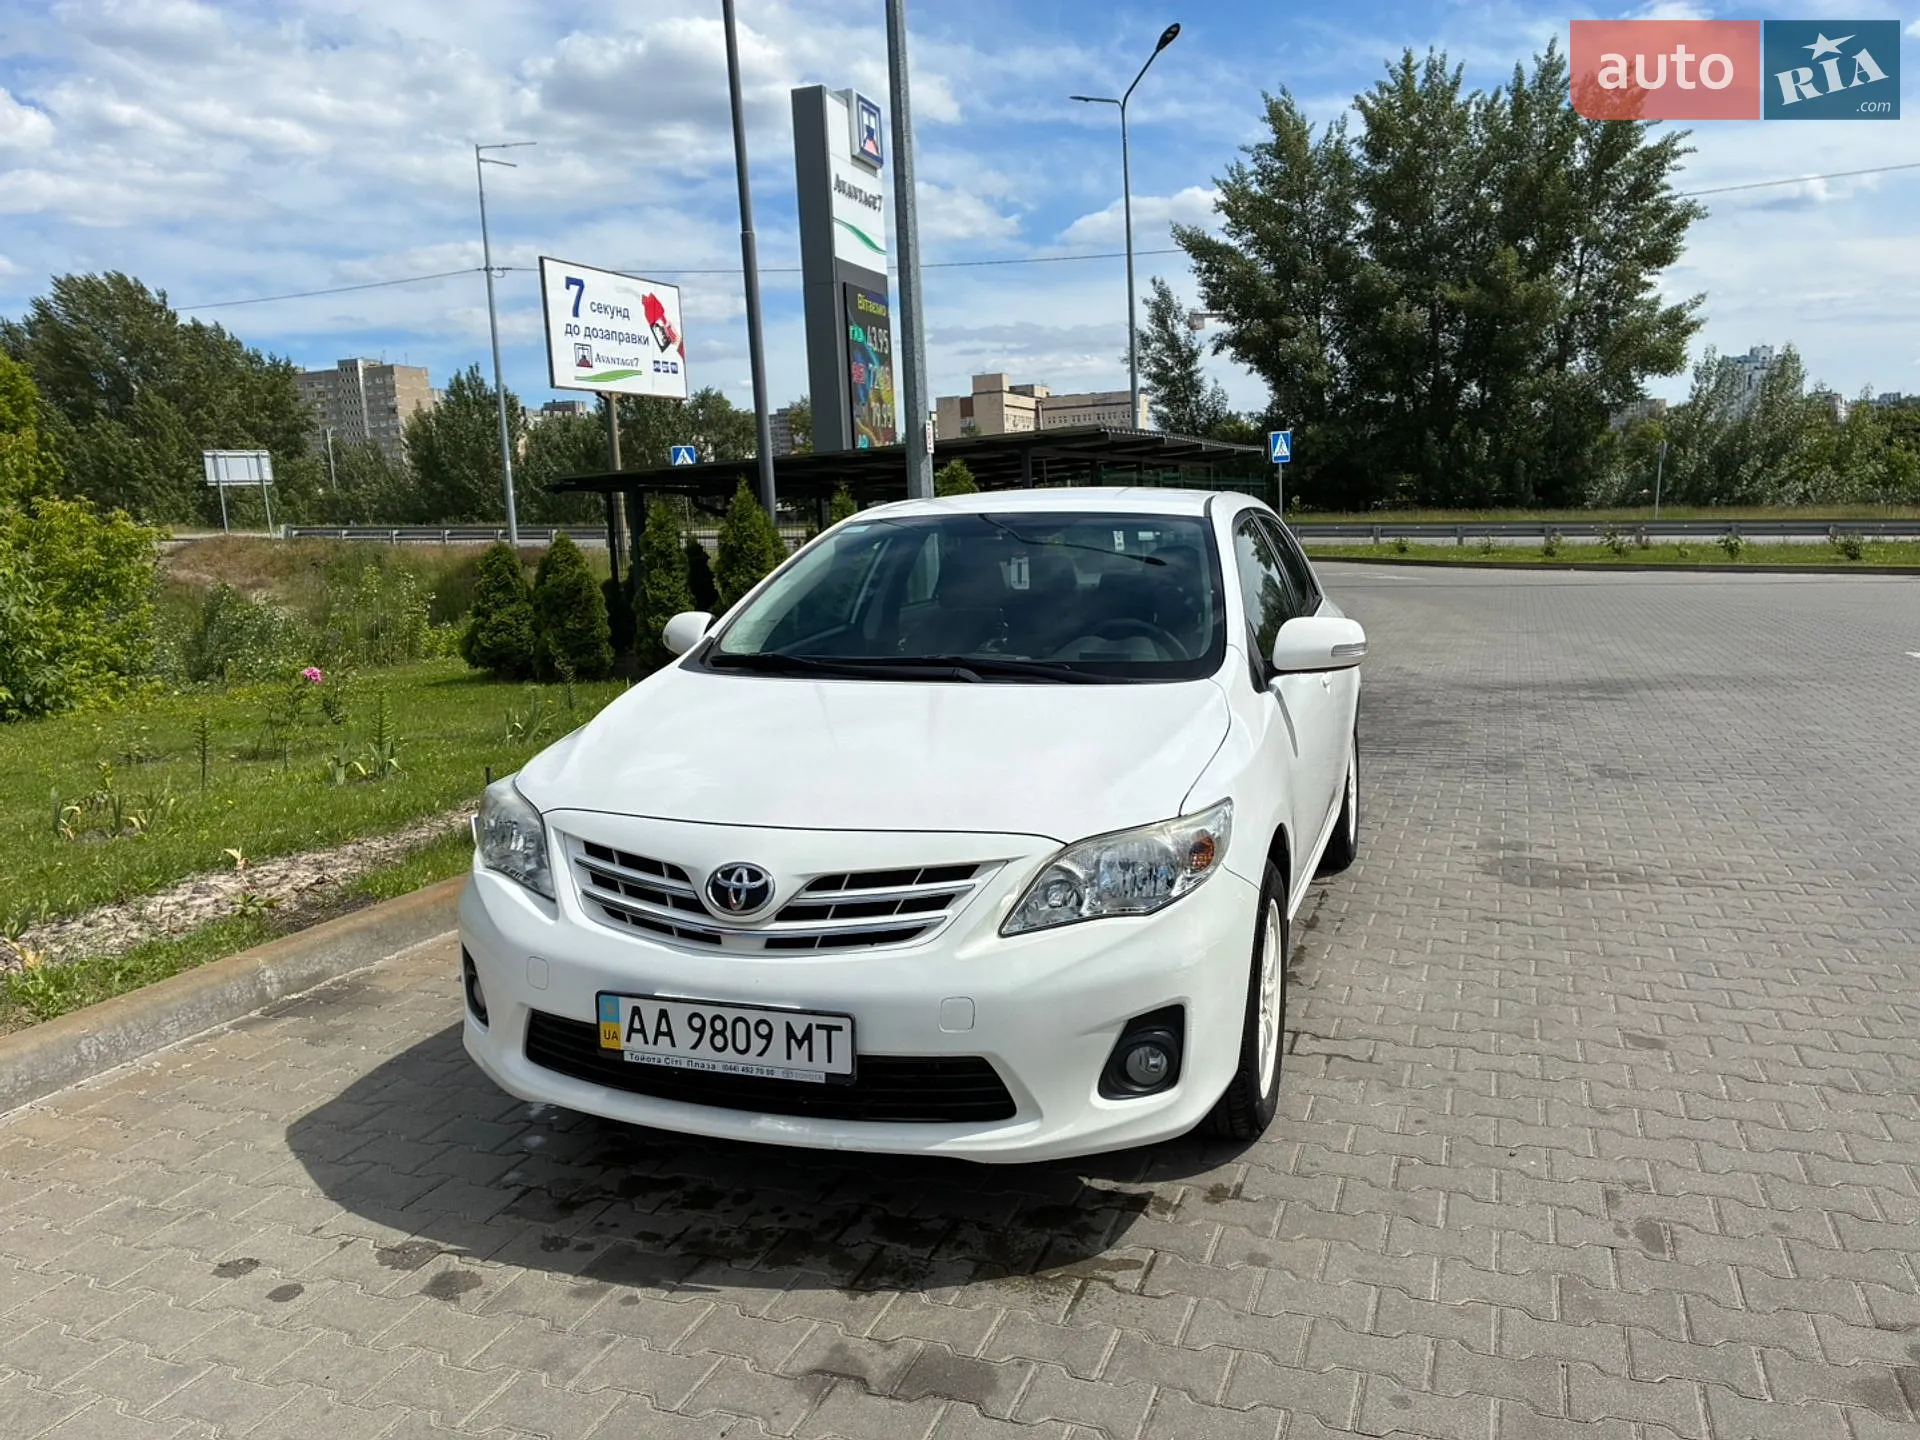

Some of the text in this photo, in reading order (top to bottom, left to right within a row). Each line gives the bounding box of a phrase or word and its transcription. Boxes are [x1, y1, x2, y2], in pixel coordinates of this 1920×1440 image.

[565, 276, 631, 321] 7 секунд
[564, 322, 650, 346] до дозаправки
[603, 1030, 619, 1041] UA
[625, 1005, 844, 1064] AA 9809 MT
[686, 1059, 716, 1070] Плаза
